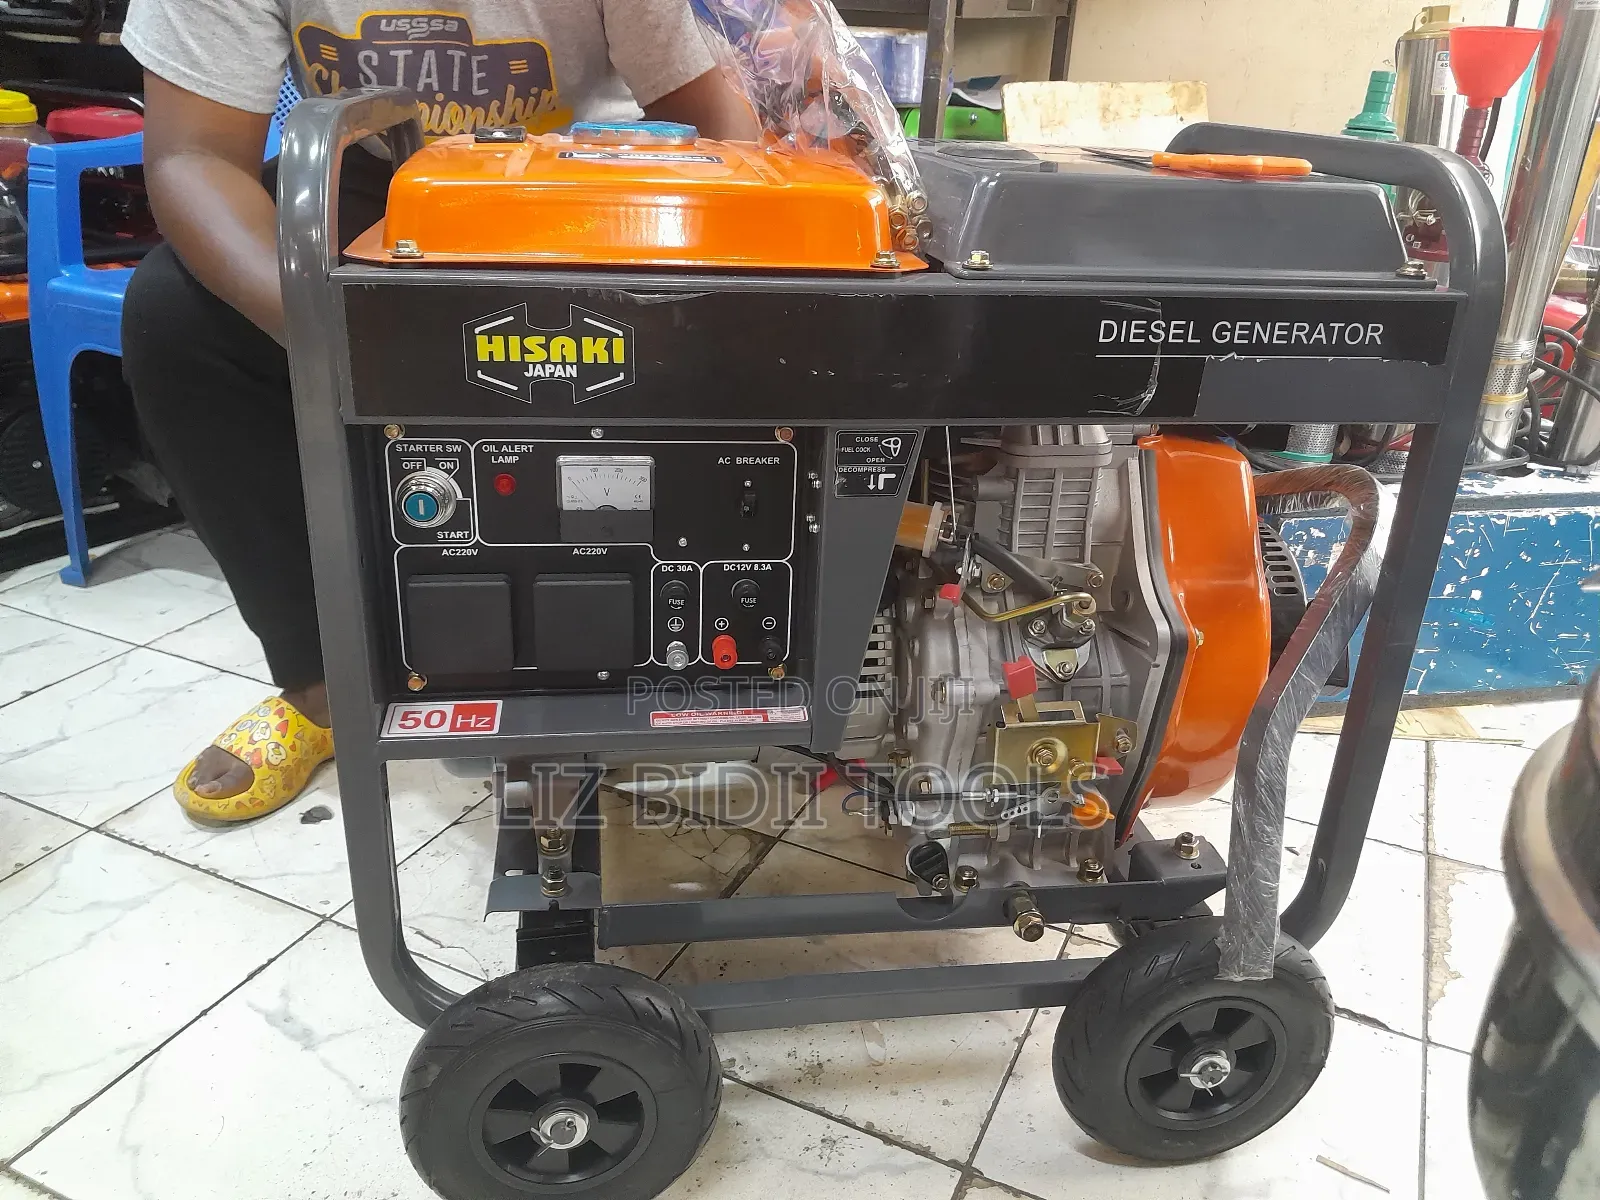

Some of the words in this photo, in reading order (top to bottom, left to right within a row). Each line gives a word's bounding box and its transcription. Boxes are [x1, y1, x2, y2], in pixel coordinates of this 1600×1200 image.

[357, 49, 490, 96] STATE
[1098, 319, 1201, 344] DIESEL
[1211, 321, 1384, 345] GENERATOR
[475, 335, 625, 364] HISAKI
[523, 363, 578, 378] JAPAN
[395, 444, 443, 453] STARTER
[445, 444, 462, 453] SW
[482, 444, 499, 453] OIL
[501, 444, 534, 453] ALERT
[491, 455, 520, 464] LAMP
[717, 456, 731, 465] AC
[735, 456, 780, 466] BREAKER
[402, 461, 423, 470] OFF
[438, 461, 454, 470] ON
[603, 487, 611, 497] V
[436, 531, 470, 539] START
[441, 548, 479, 557] AC220V
[572, 547, 608, 556] AC220V
[676, 564, 693, 572] 30A
[723, 563, 752, 571] DC12V
[753, 563, 773, 571] 8.3A
[668, 598, 685, 606] FUSE
[397, 709, 448, 730] 50
[455, 714, 492, 729] Hz
